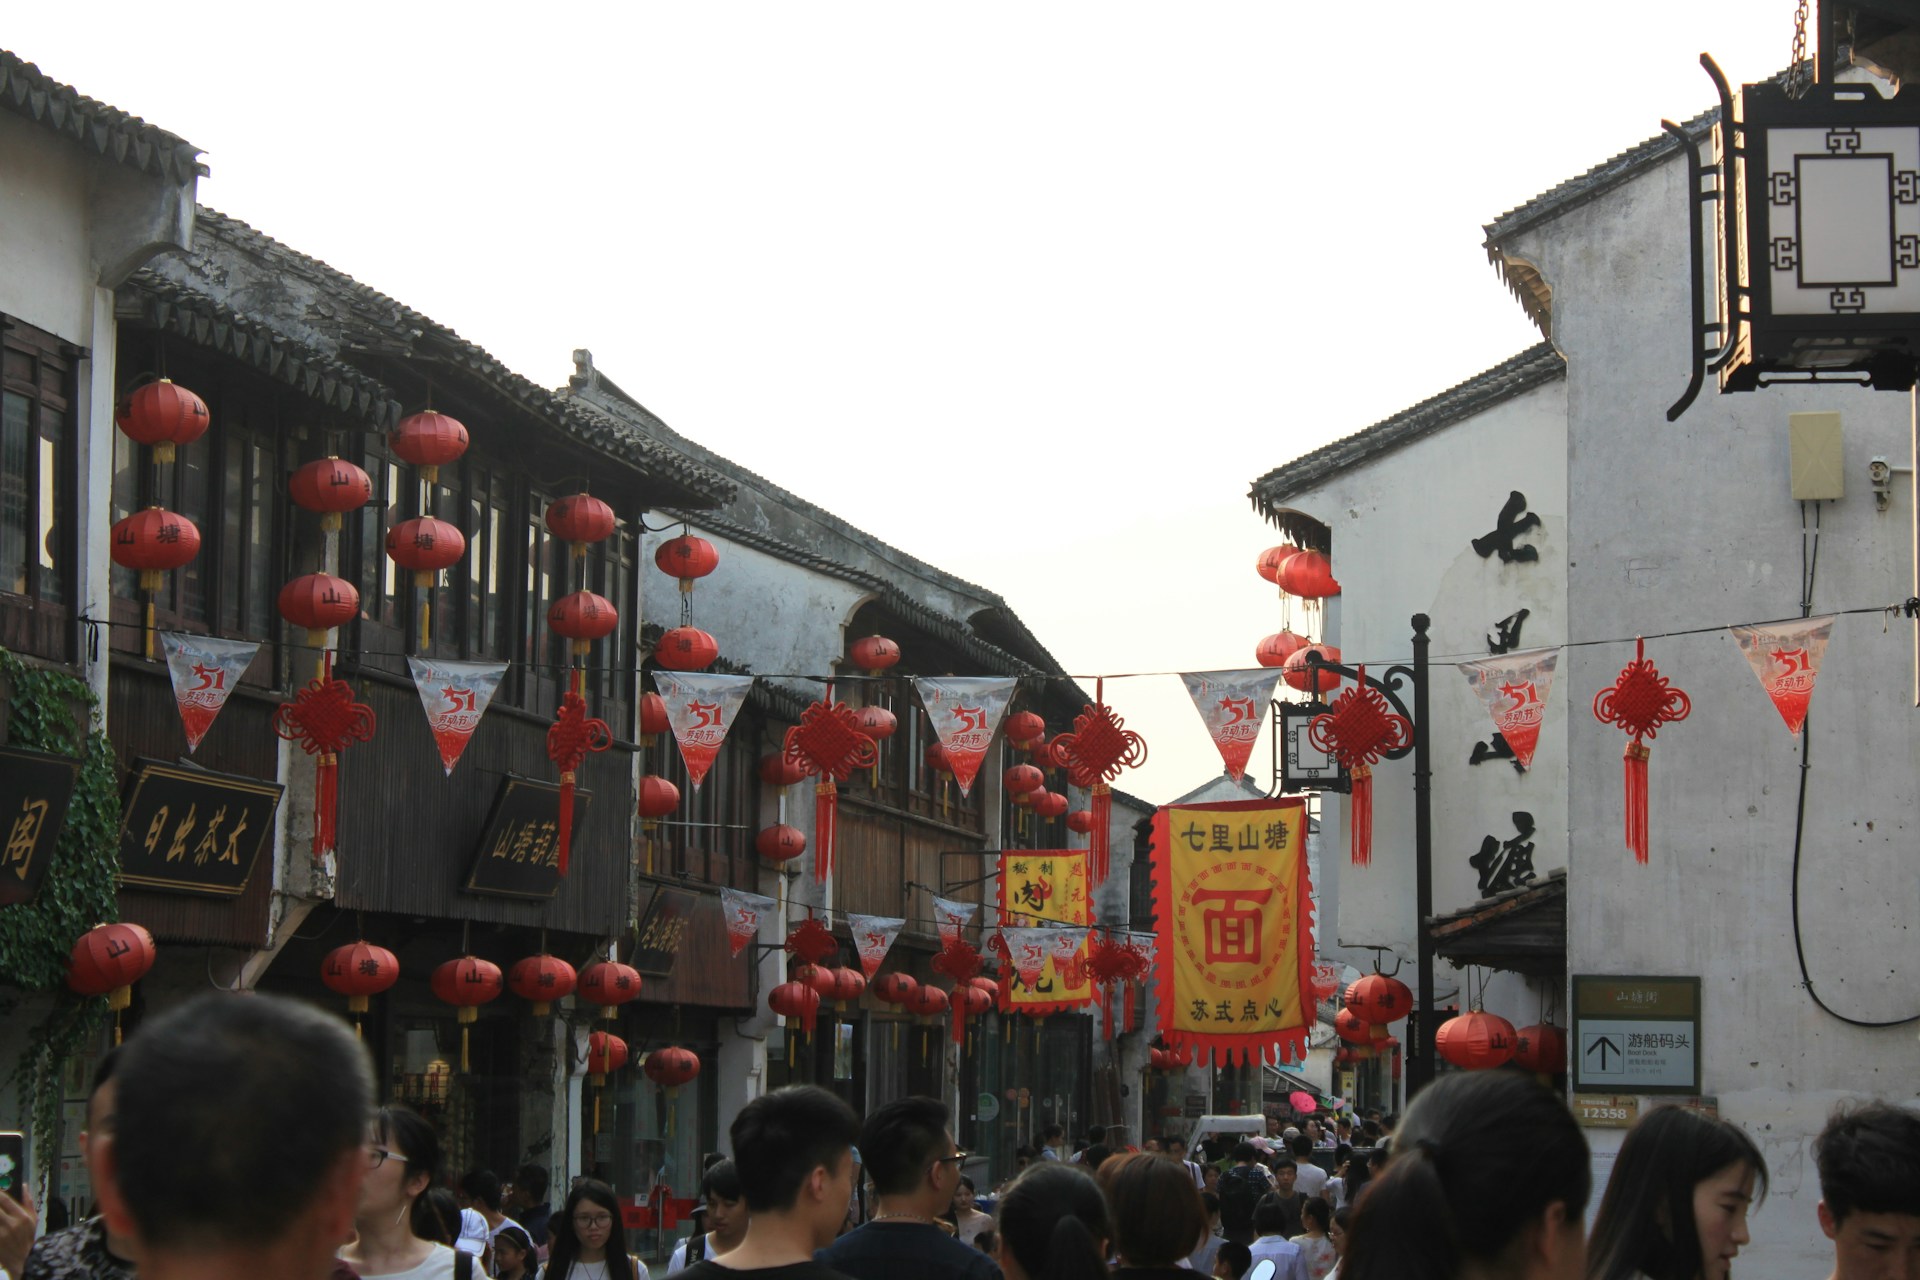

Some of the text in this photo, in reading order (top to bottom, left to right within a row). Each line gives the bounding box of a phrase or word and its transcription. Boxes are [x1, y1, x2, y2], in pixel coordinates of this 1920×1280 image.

[117, 523, 181, 546] 山塘
[553, 604, 599, 621] 山塘
[1770, 647, 1812, 680] 51
[188, 662, 225, 691] 51
[1775, 676, 1806, 688] 劳动节
[186, 690, 217, 703] 劳动节
[438, 684, 478, 715] 51
[1499, 680, 1541, 713] 51
[687, 699, 723, 730] 51
[950, 703, 989, 735] 51
[1218, 694, 1258, 727] 51
[1505, 708, 1534, 721] 劳动节
[439, 714, 469, 726] 劳动节
[687, 729, 716, 741] 劳动节
[950, 733, 982, 745] 劳动节
[1220, 725, 1251, 737] 劳动节
[1, 795, 49, 880] 阁
[143, 802, 248, 867] 日出茶太
[1181, 820, 1289, 853] 七里山塘
[1012, 860, 1053, 876] 秘制
[1191, 887, 1273, 965] 面
[328, 958, 380, 977] 山塘
[585, 974, 630, 990] 山塘
[1353, 993, 1395, 1009] 山塘
[1616, 991, 1658, 1004] 山塘街
[1190, 998, 1283, 1024] 苏式点心
[1491, 1033, 1507, 1049] 山
[1627, 1033, 1690, 1049] 游船码头
[1583, 1108, 1627, 1119] 12358
